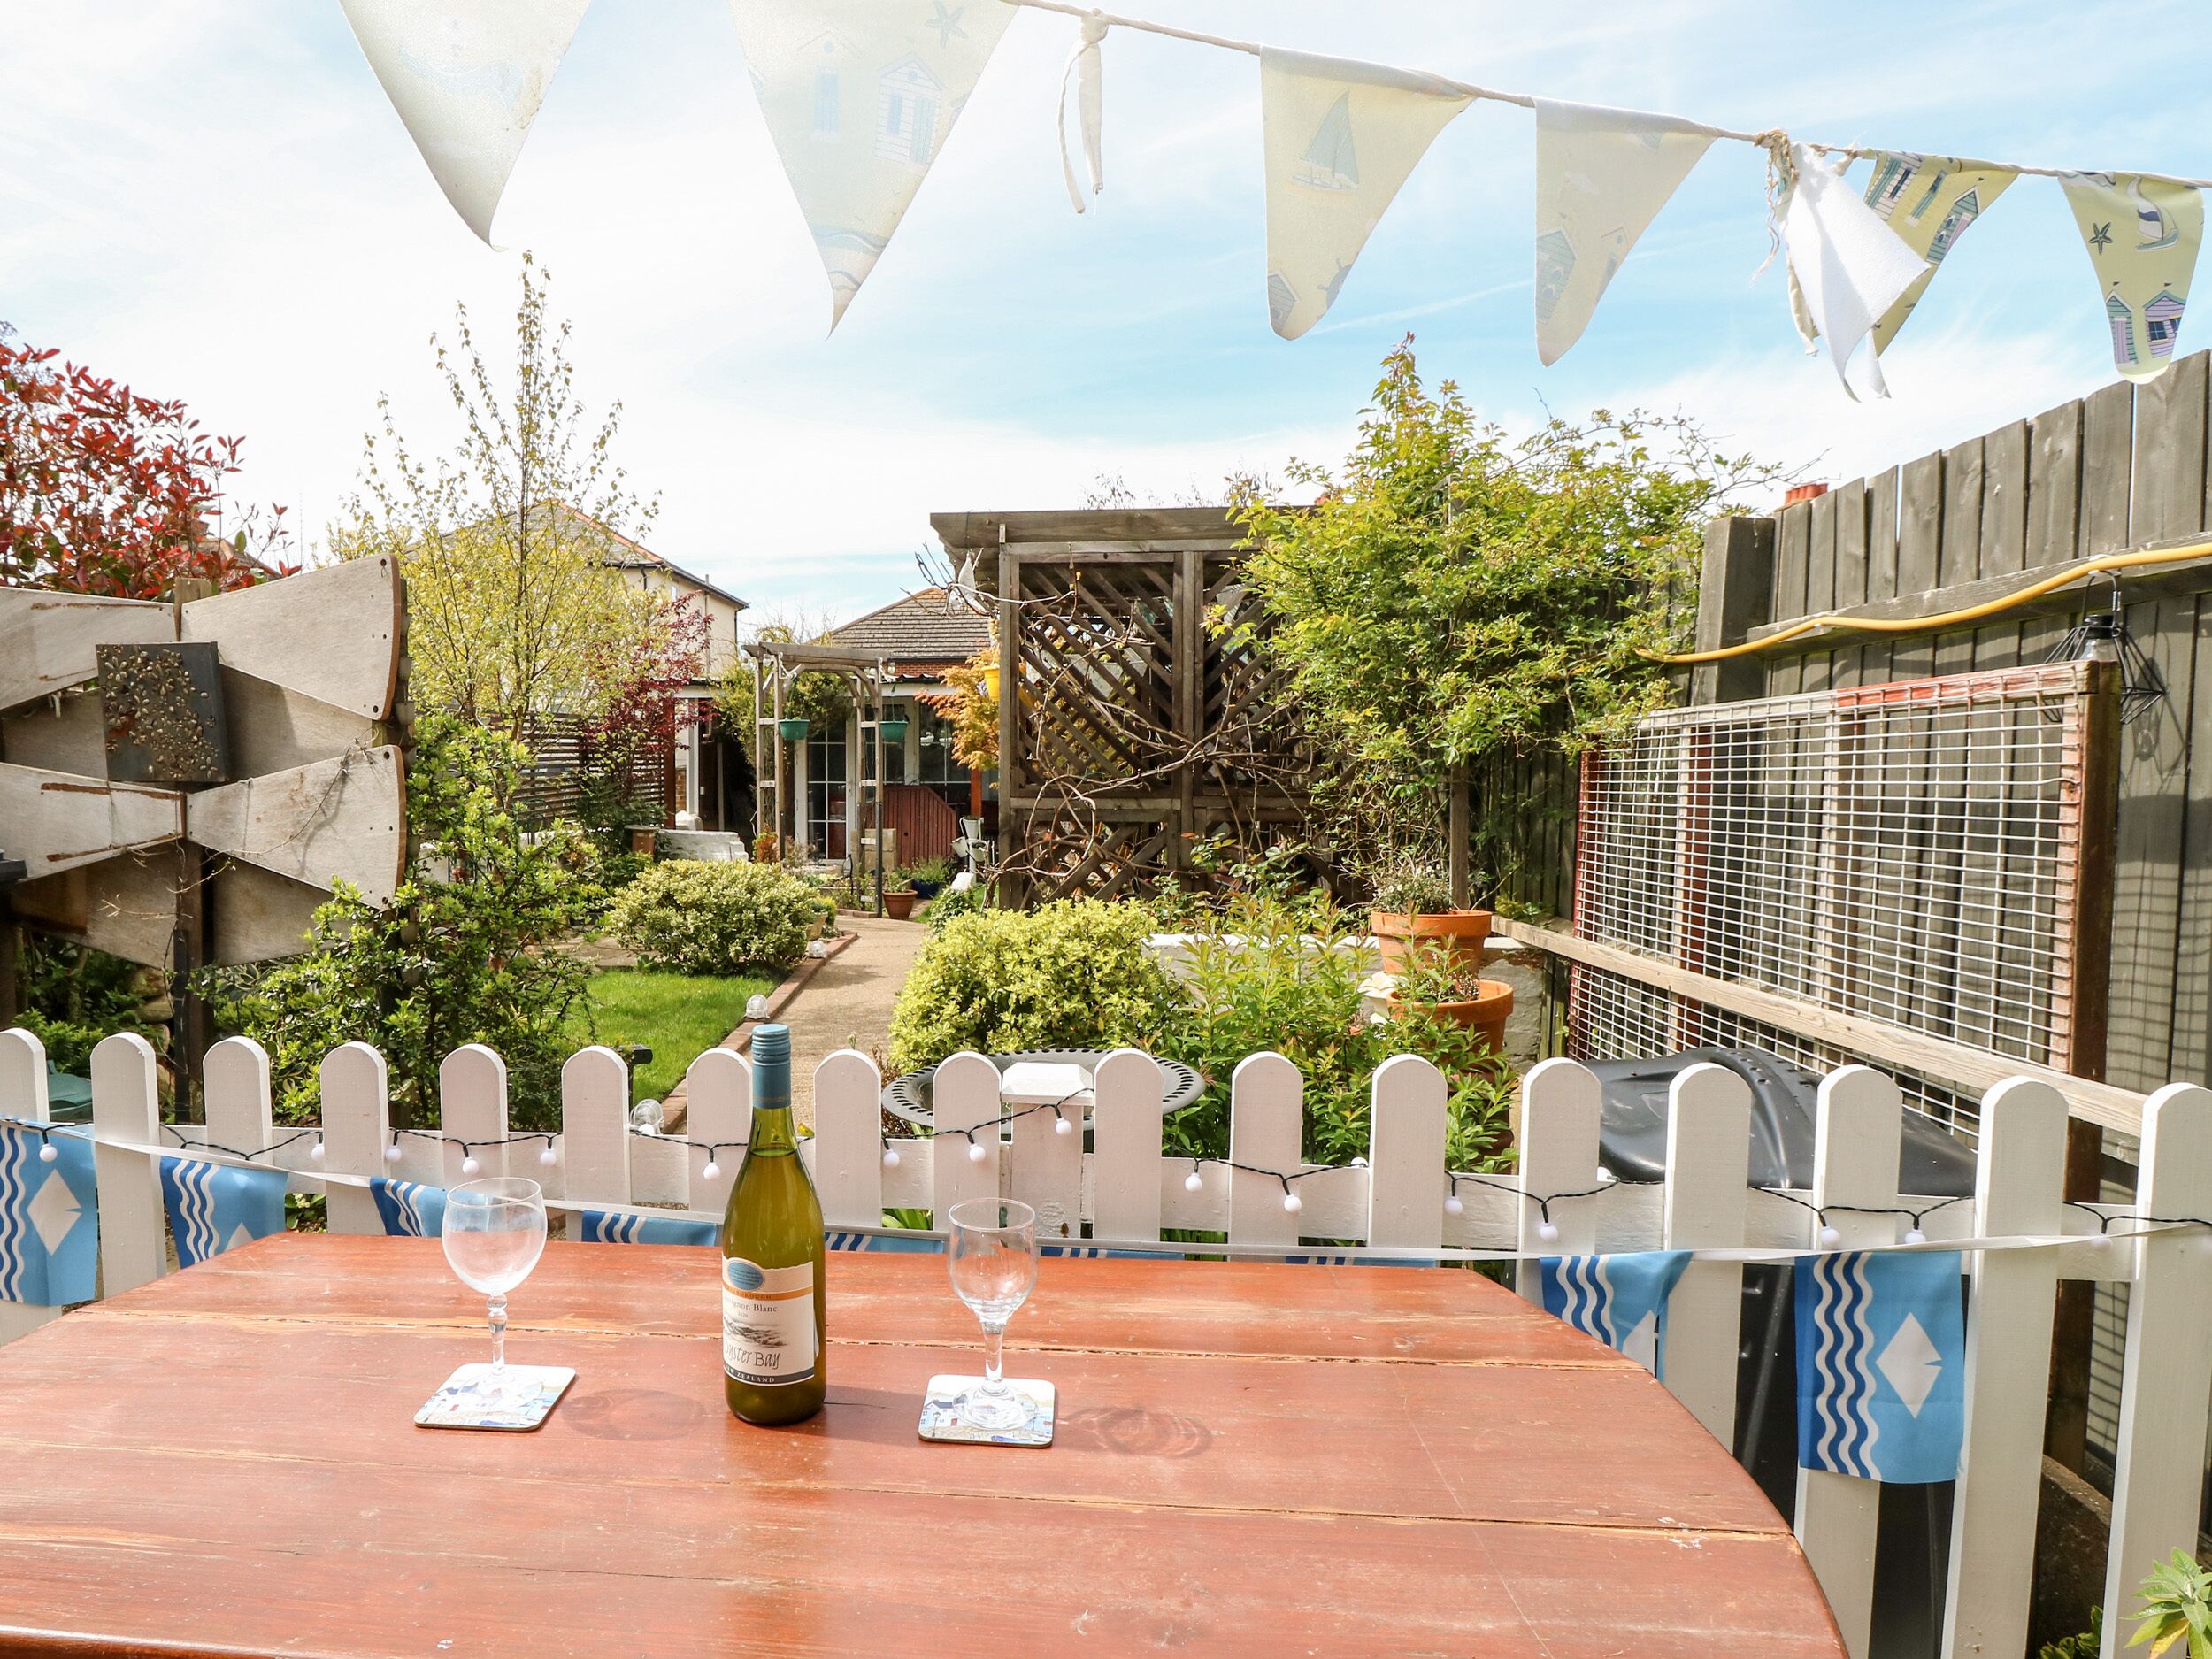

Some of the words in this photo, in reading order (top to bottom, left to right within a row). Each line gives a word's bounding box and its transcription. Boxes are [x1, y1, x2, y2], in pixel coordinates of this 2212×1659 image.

[725, 1285, 772, 1300] RLBOROUGH
[753, 1303, 778, 1312] Blanc
[753, 1351, 780, 1370] Bay
[736, 1372, 774, 1383] ZEALAND
